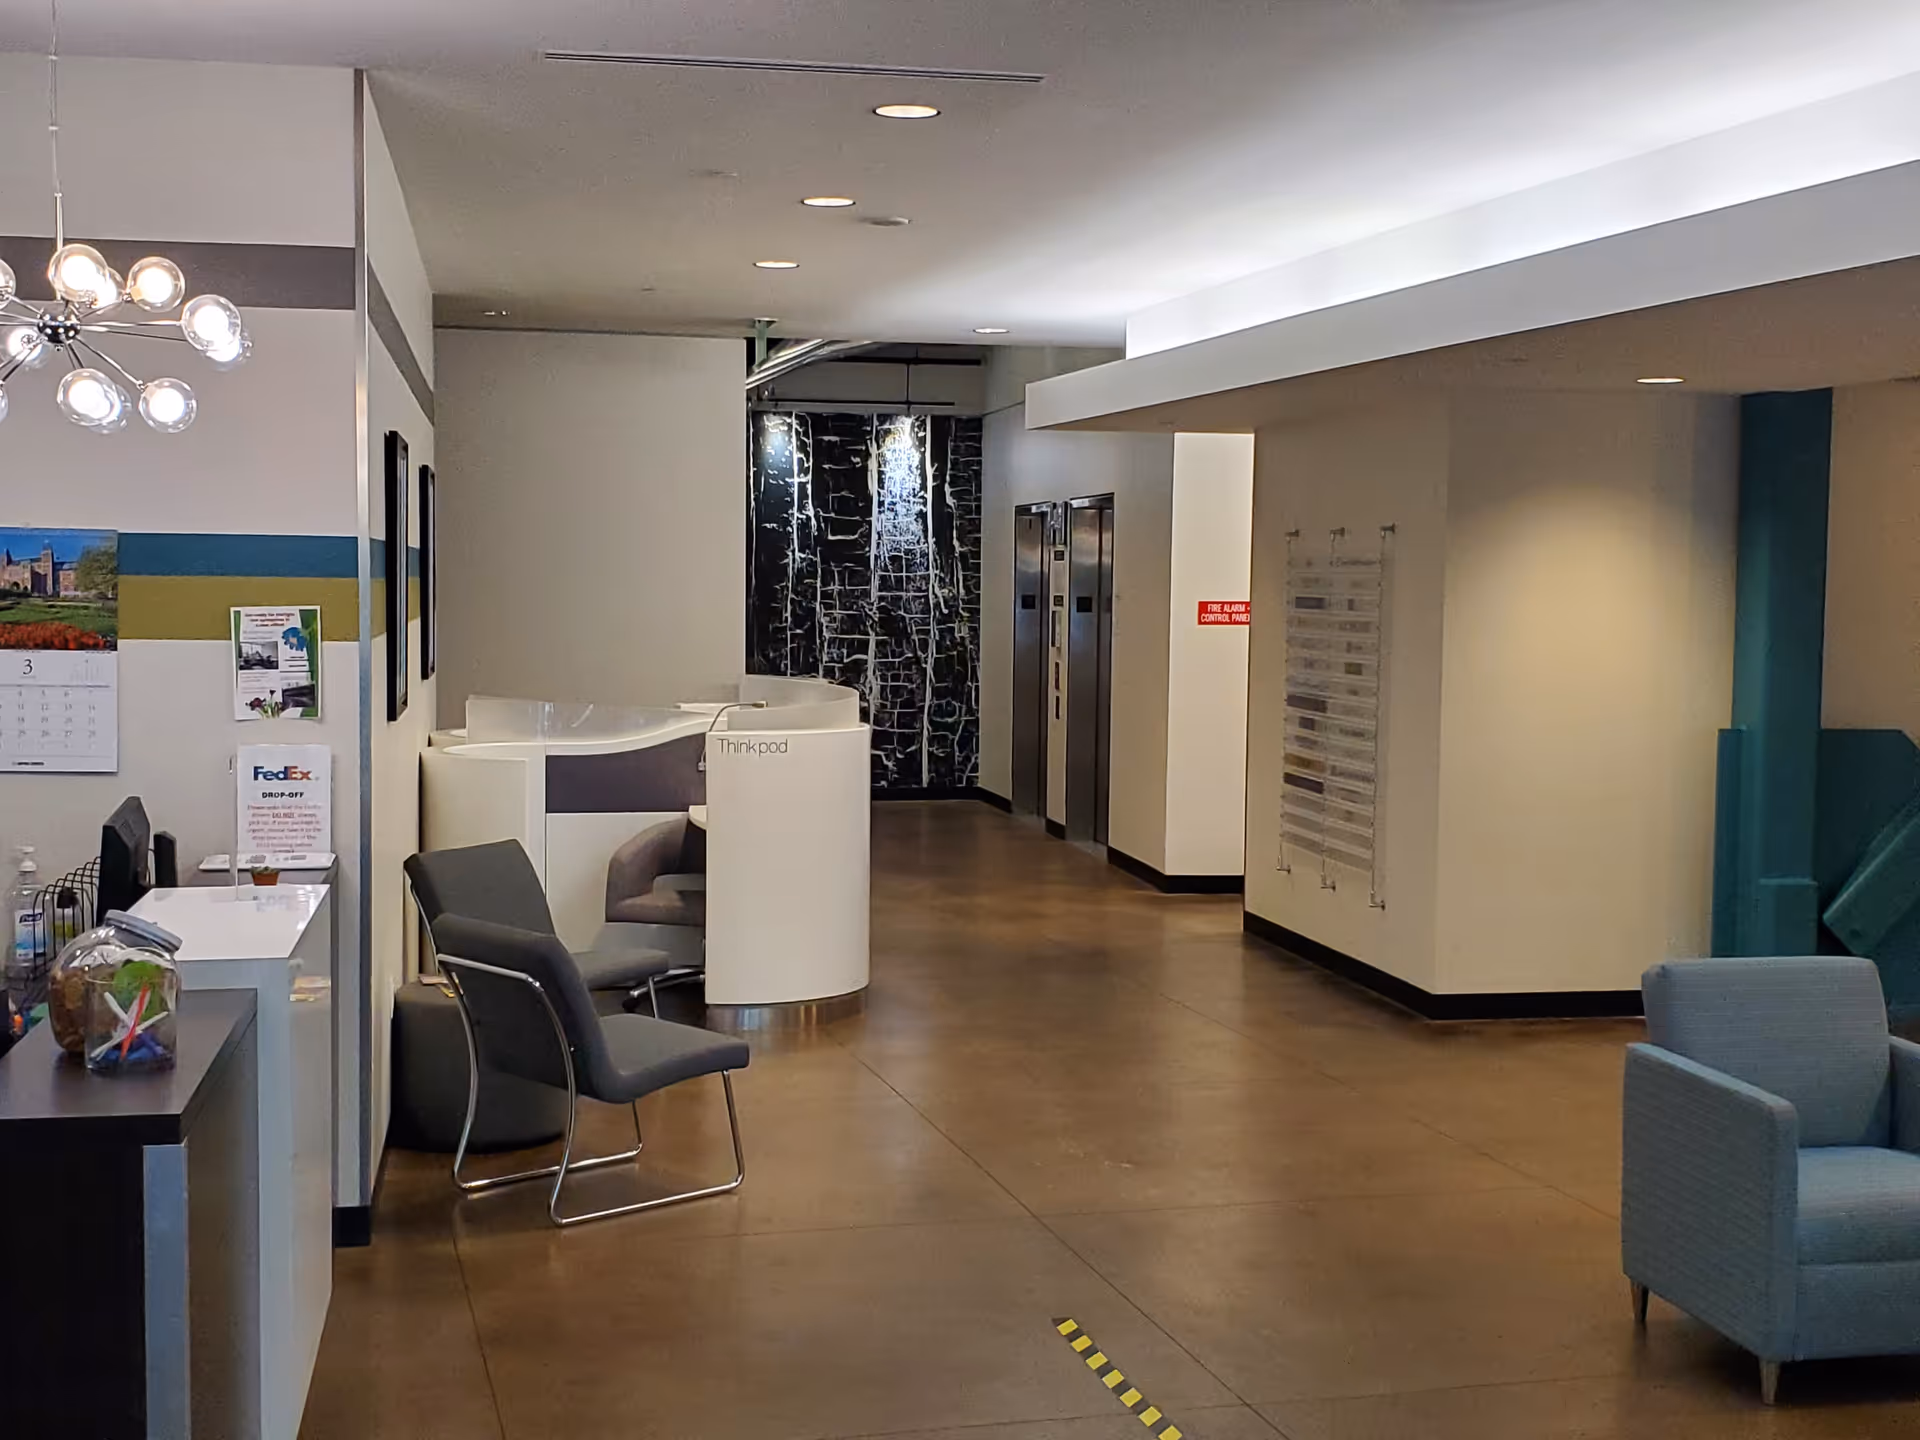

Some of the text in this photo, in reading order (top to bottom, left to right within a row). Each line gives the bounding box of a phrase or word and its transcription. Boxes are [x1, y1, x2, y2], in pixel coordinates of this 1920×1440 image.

[1207, 603, 1246, 613] FIRE ALARM
[1200, 613, 1230, 622] CONTROL
[22, 658, 33, 675] 3
[253, 765, 312, 781] FedEx
[261, 791, 304, 799] DROP-OFF
